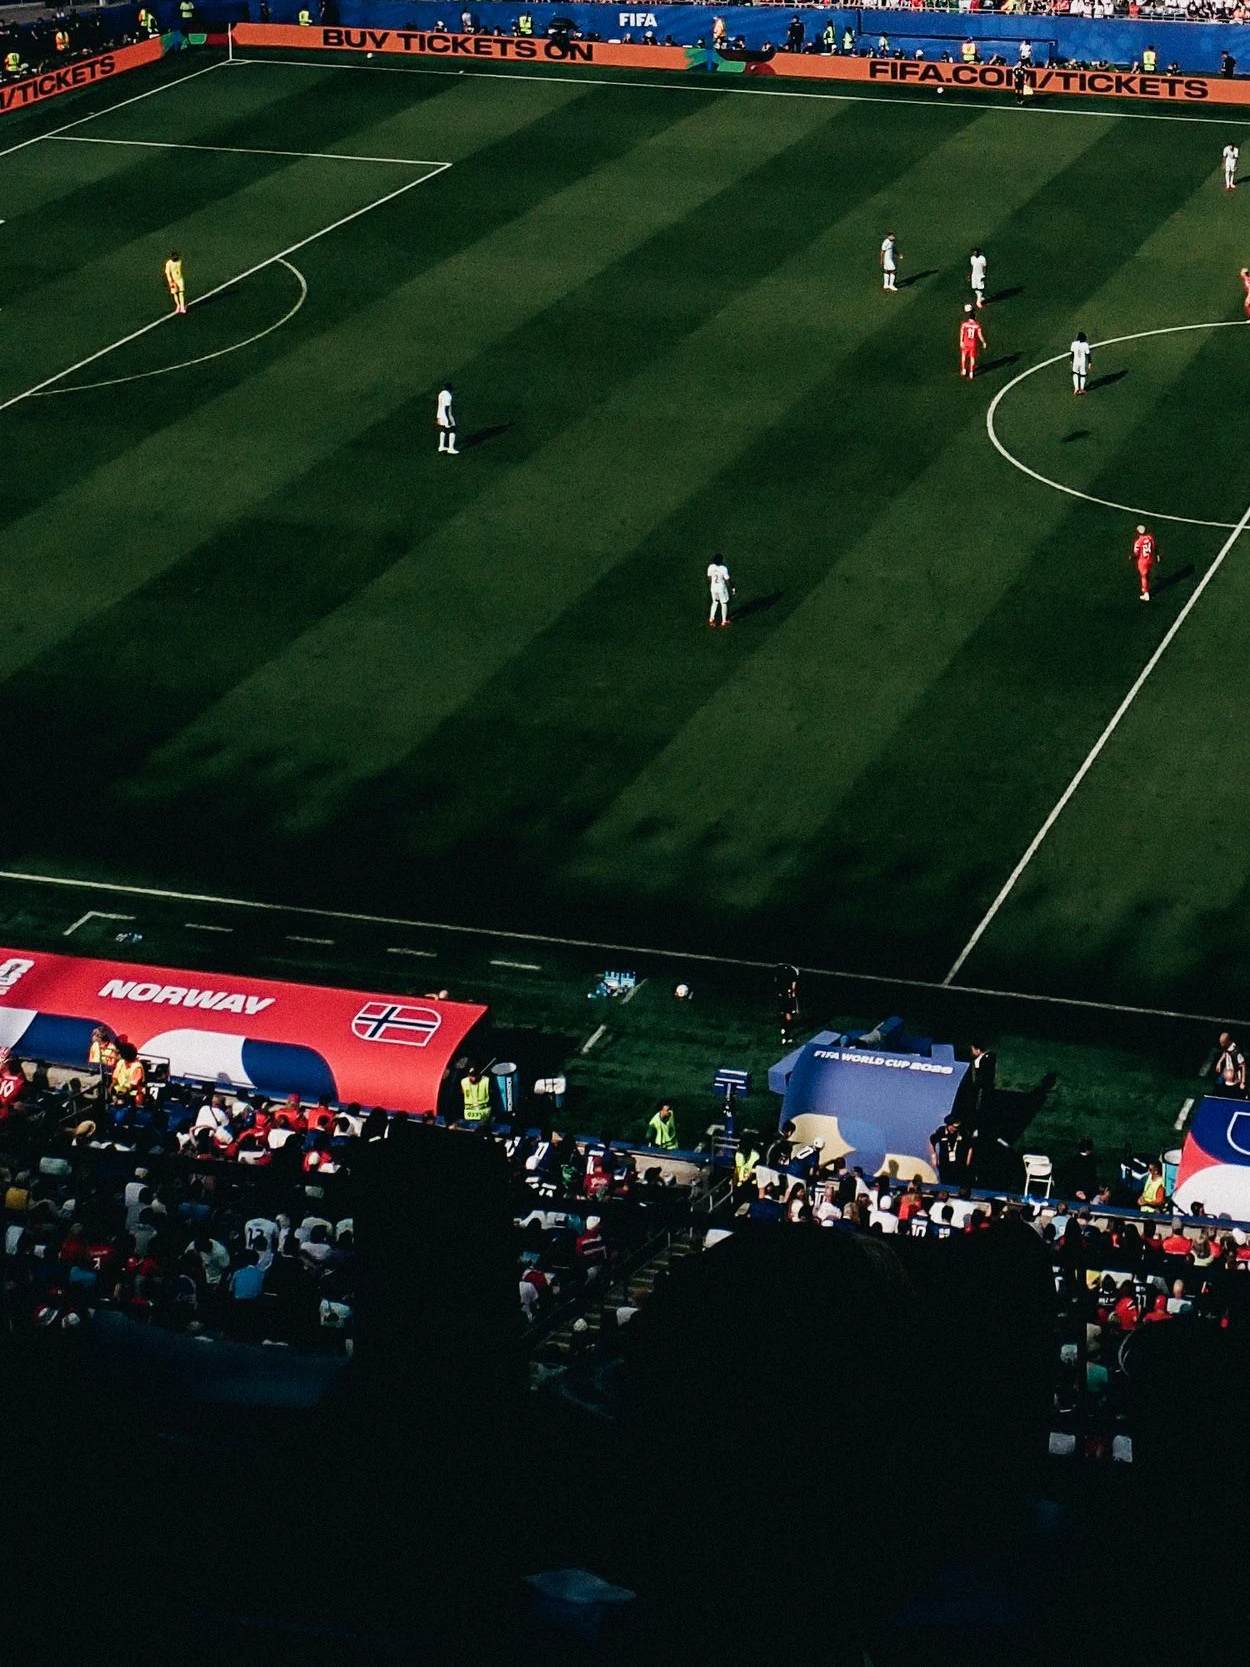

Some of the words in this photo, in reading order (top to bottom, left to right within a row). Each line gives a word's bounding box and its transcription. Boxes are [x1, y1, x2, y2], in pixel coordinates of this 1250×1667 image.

[618, 13, 658, 28] FIFA
[323, 28, 389, 50] BUY
[399, 33, 537, 58] TICKETS
[98, 979, 276, 1015] NORWAY
[814, 1049, 840, 1061] FIFA
[841, 1052, 884, 1066] WORLD
[885, 1057, 910, 1069] CUP
[910, 1061, 954, 1075] 2026
